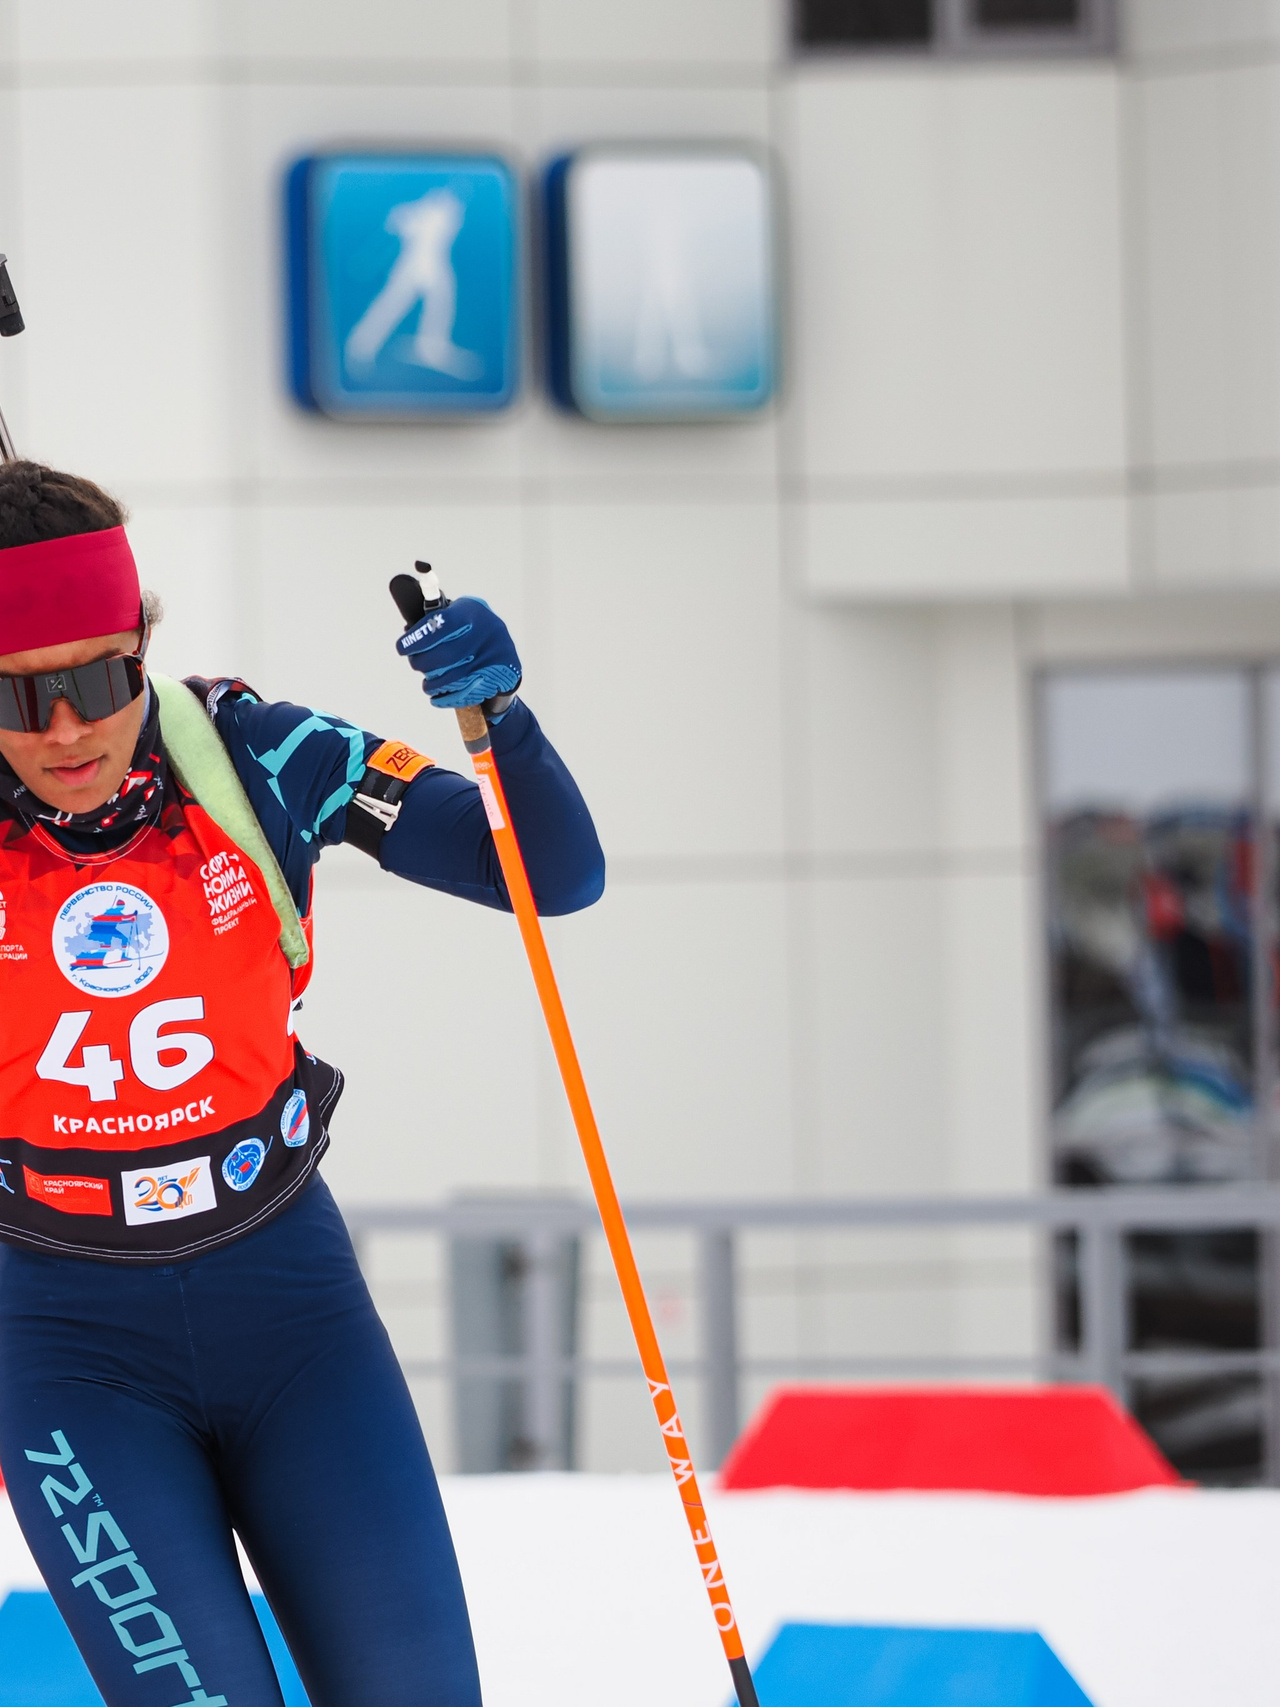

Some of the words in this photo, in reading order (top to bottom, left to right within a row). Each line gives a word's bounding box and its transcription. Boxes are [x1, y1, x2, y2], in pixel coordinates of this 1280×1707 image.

[203, 866, 247, 898] НОРМА
[207, 881, 254, 916] ЖИЗНИ
[59, 885, 113, 920] ПЕРВЕНСТВО
[116, 885, 153, 910] РОССИИ
[214, 917, 239, 936] ПРОЕКТ
[79, 978, 132, 993] Красноярск
[35, 995, 215, 1102] 46
[53, 1095, 216, 1134] КРАСНОЯРСК
[43, 1179, 104, 1190] КРАСНОЯРСКИЙ
[134, 1176, 183, 1210] 20
[646, 1376, 694, 1487] WAY
[693, 1519, 736, 1632] ONE
